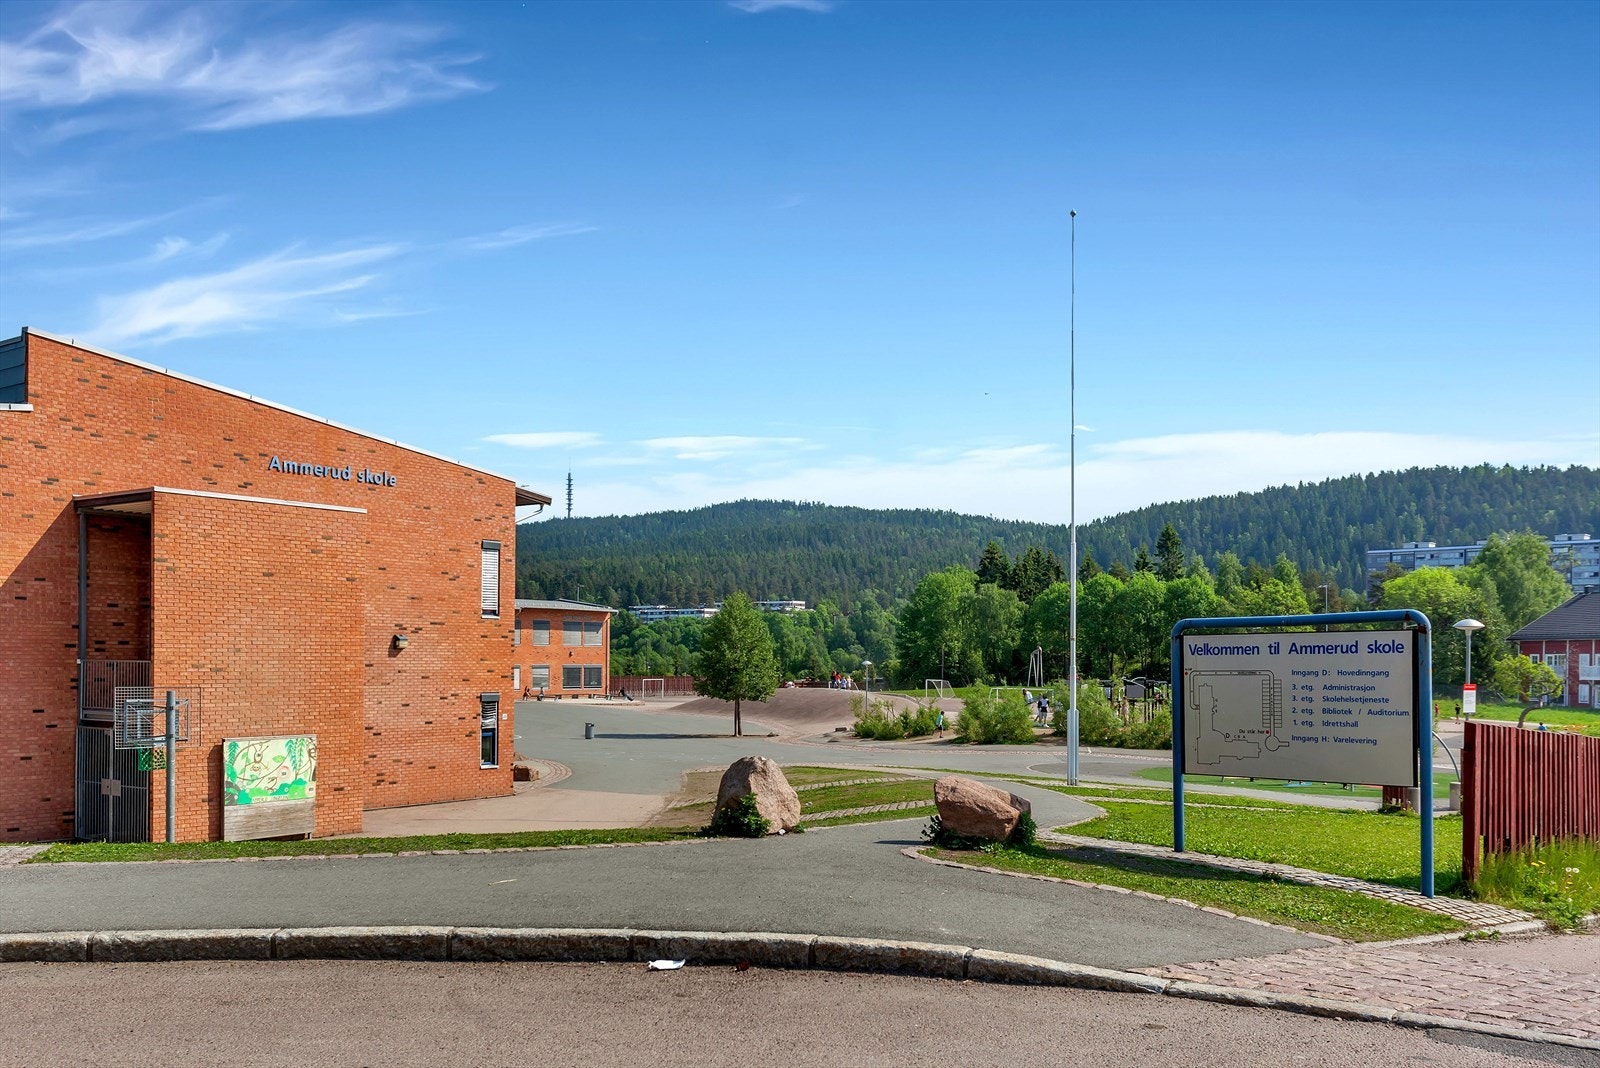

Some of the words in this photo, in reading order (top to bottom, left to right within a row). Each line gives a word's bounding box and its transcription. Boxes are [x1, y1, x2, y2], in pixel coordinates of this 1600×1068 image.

[268, 455, 352, 480] Ammerud
[357, 468, 397, 487] skole
[1188, 643, 1260, 656] Velkommen
[1268, 641, 1280, 655] til
[1288, 640, 1359, 655] Ammerud
[1367, 639, 1404, 654] skole
[1291, 669, 1319, 677] Inngang
[1337, 669, 1390, 678] Hovedinngang
[1301, 684, 1315, 692] etg.
[1322, 684, 1376, 692] Administrasjon
[1301, 695, 1315, 703] etg.
[1322, 695, 1390, 704] Skolehelsetjeneste
[1301, 707, 1315, 715] etg.
[1322, 707, 1353, 715] Bibliotek
[1367, 708, 1410, 717] Auditorium
[1301, 719, 1315, 728] etg.
[1322, 720, 1359, 728] Idrettshall
[1291, 734, 1319, 743] Inngang
[1321, 735, 1330, 743] H:
[1333, 736, 1378, 746] Varelevering
